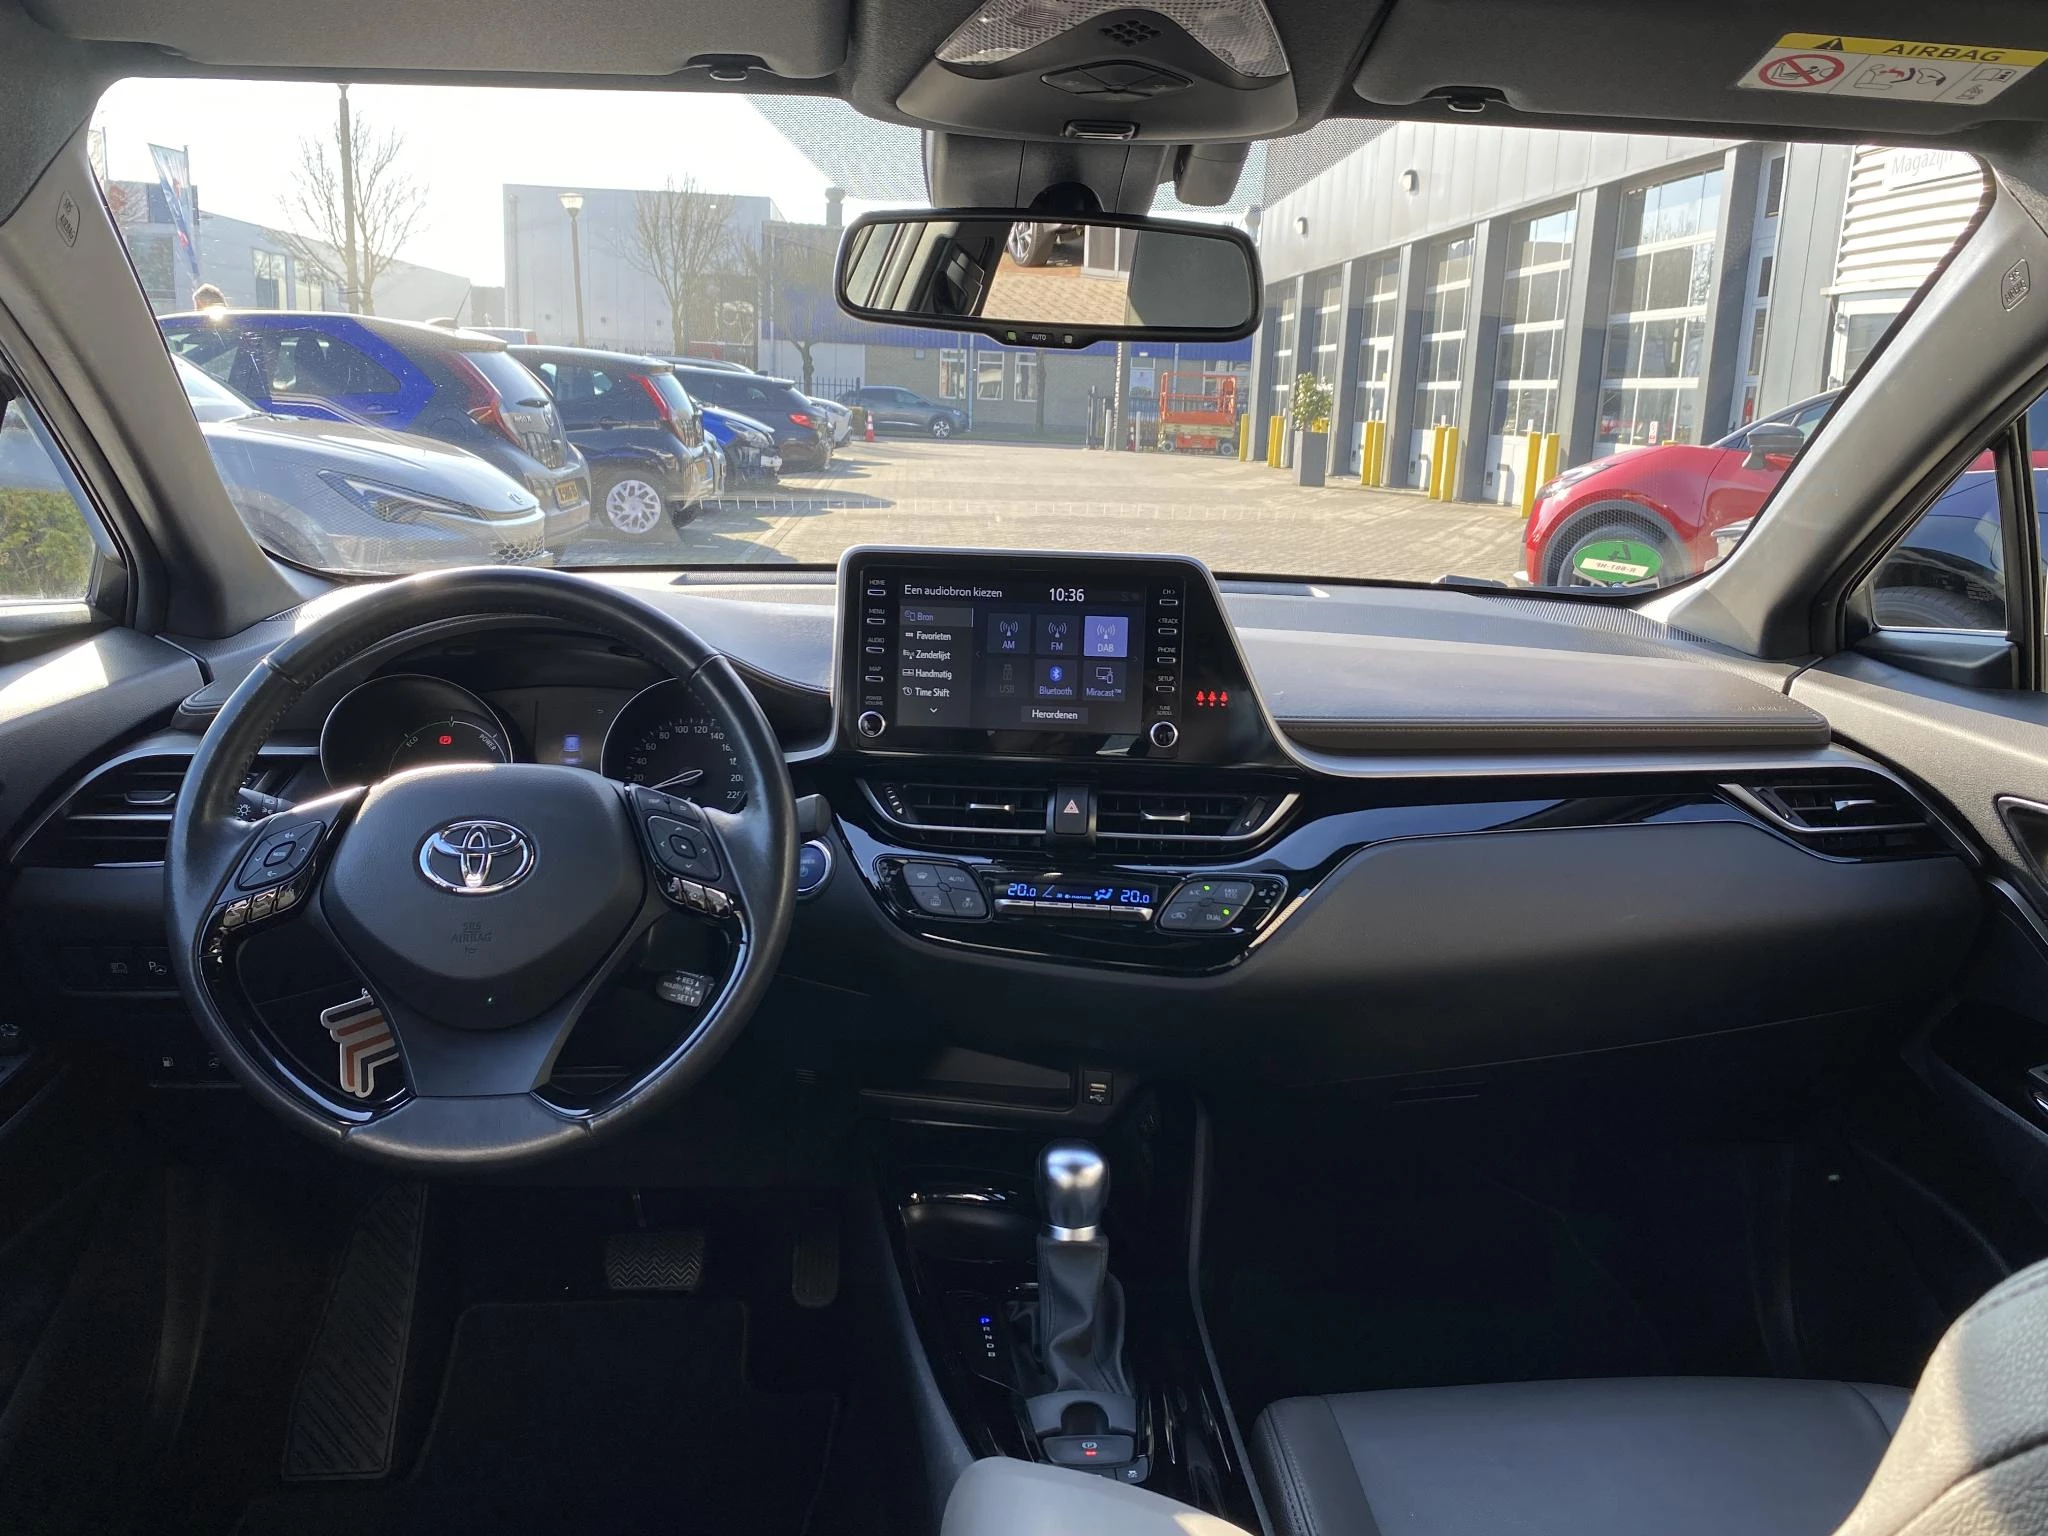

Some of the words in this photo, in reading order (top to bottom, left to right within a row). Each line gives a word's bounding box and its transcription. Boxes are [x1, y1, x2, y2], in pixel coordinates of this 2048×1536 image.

[1882, 43, 2006, 61] AIRBAG
[1892, 152, 1953, 176] Magazijn
[1031, 333, 1047, 341] AUTO
[904, 584, 922, 595] Een
[924, 585, 972, 597] audiobron
[973, 587, 1003, 598] kiezen
[1049, 587, 1085, 602] 10:36
[917, 612, 934, 621] Bron
[916, 630, 952, 641] Favorieten
[1002, 640, 1015, 649] AM
[1050, 641, 1063, 651] FM
[1097, 643, 1115, 653] DAB
[915, 649, 951, 661] Zenderlijst
[915, 668, 953, 681] Handmatig
[914, 686, 932, 697] Time
[933, 687, 950, 698] Shift
[999, 684, 1015, 694] USB
[1039, 685, 1073, 696] Bluetooth
[1031, 709, 1079, 720] Herordenen
[674, 725, 689, 734] 100
[693, 725, 708, 734] 120
[659, 731, 670, 740] 80
[710, 732, 725, 740] 140
[406, 736, 419, 749] ECO
[479, 733, 497, 752] POWER
[645, 742, 657, 751] 60
[636, 757, 648, 766] 40
[1007, 883, 1037, 897] 20.0
[1120, 889, 1150, 904] 20.0
[1206, 913, 1222, 921] DUAL
